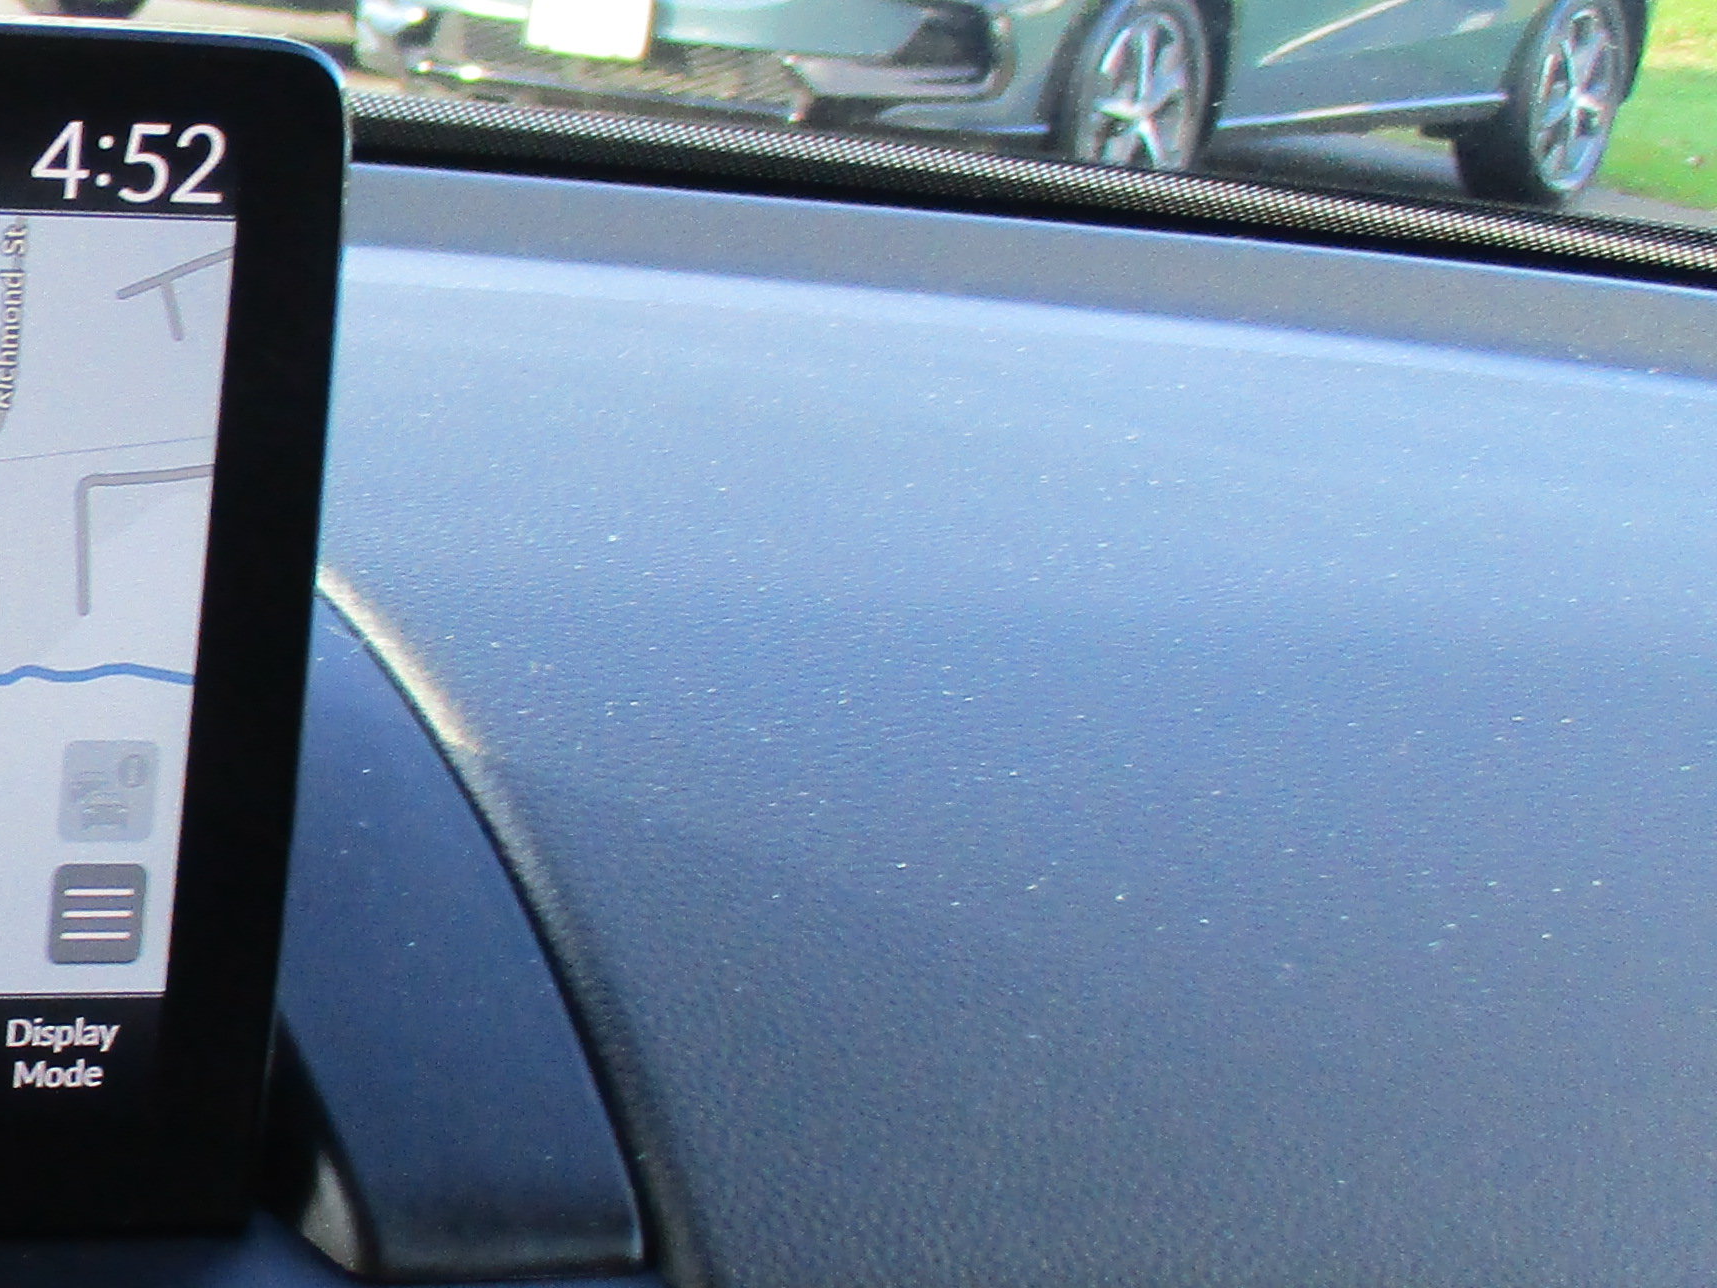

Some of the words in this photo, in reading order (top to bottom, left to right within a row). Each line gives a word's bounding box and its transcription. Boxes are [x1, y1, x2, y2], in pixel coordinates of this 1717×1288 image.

[30, 120, 228, 205] 4:52
[0, 224, 28, 256] St
[6, 1017, 121, 1053] Display
[13, 1059, 105, 1089] Mode
